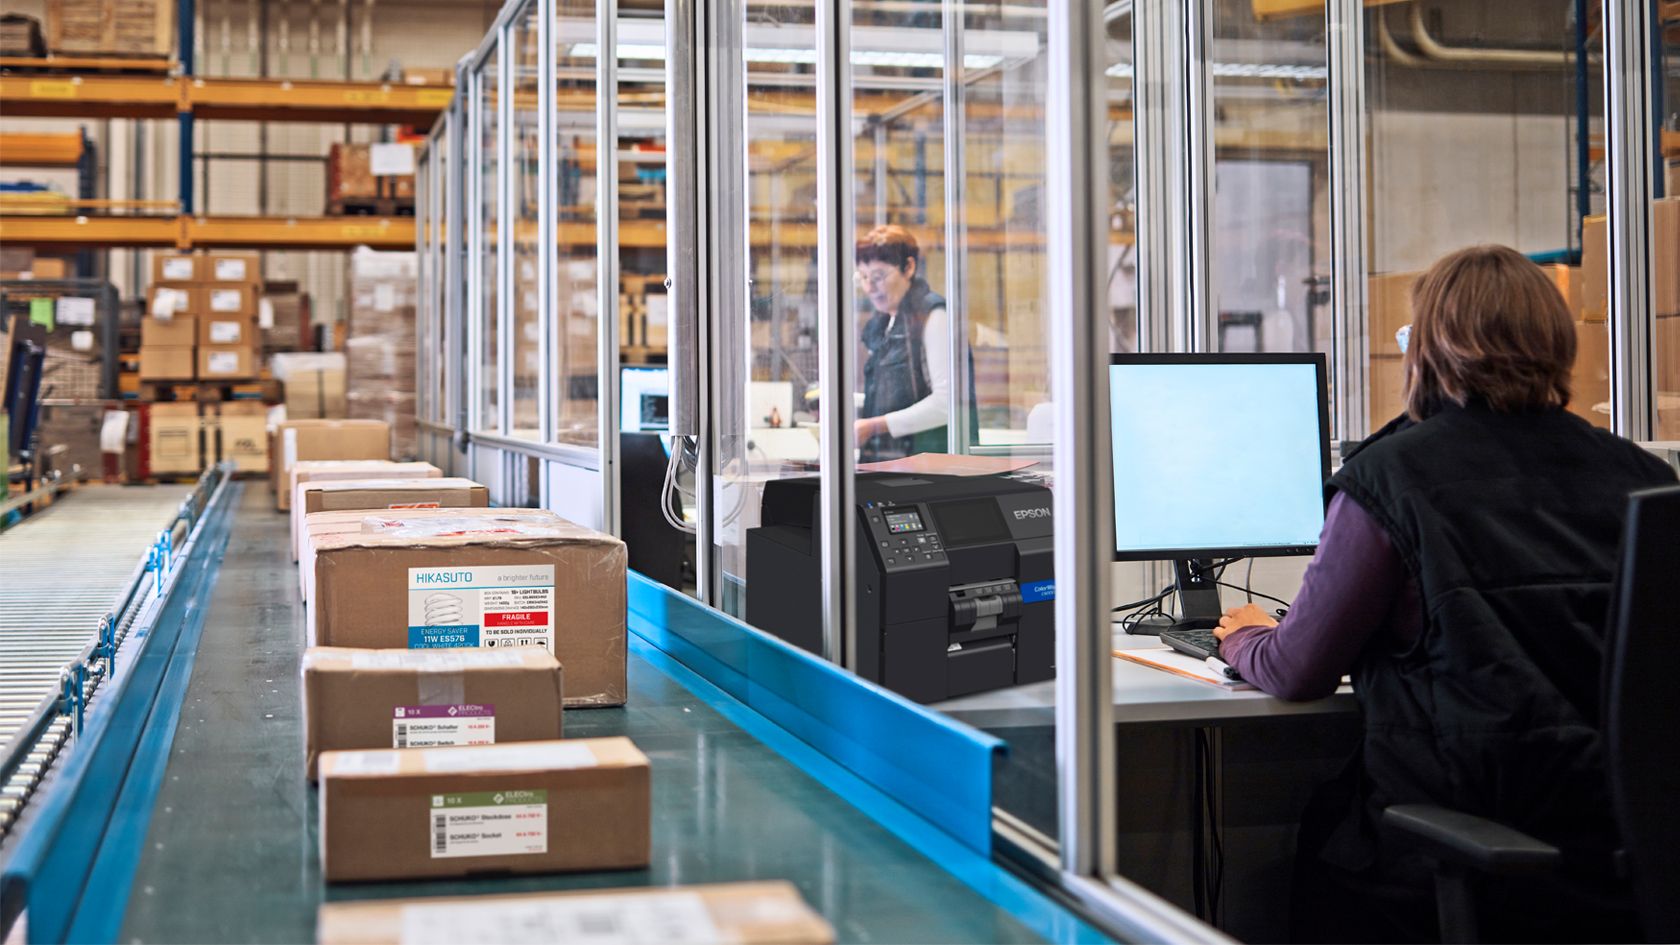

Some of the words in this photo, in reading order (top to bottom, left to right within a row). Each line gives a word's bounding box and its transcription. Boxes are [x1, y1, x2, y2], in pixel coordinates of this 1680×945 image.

[1013, 507, 1051, 520] EPSON
[416, 572, 473, 583] HIKASUTO
[502, 574, 529, 582] brighter
